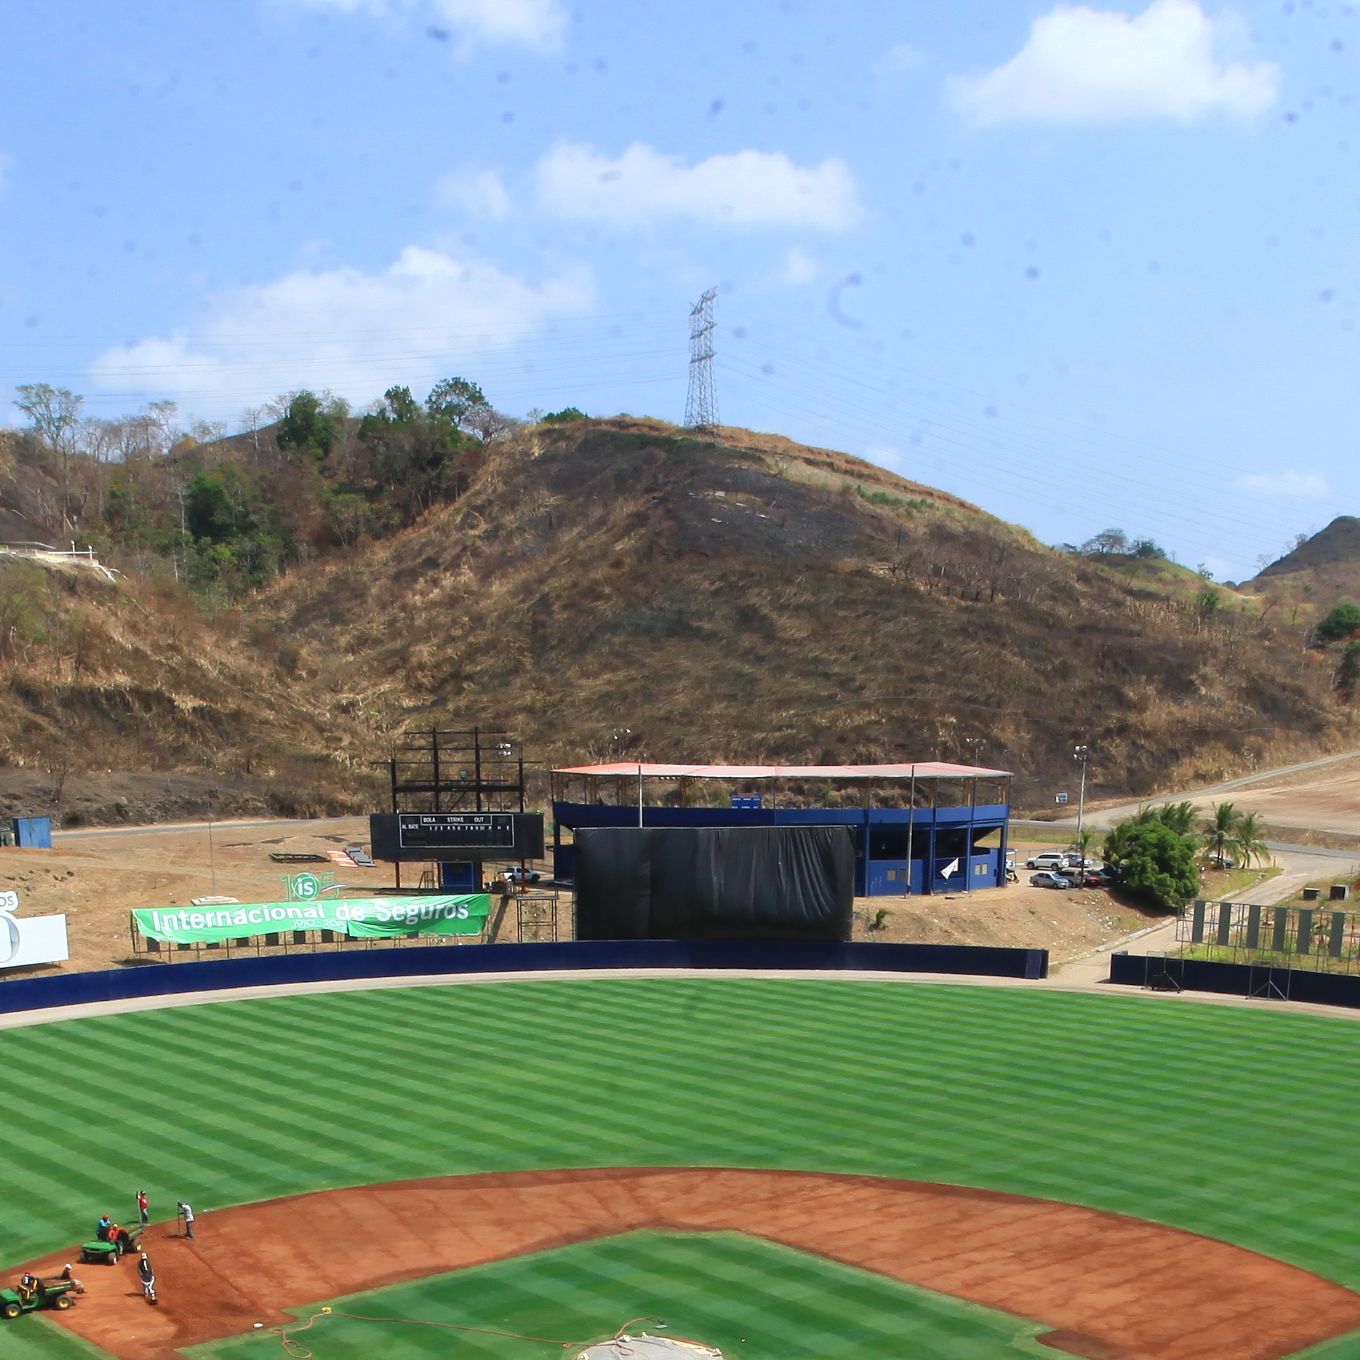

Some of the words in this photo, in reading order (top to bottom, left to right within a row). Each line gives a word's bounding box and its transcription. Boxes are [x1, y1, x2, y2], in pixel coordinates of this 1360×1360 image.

[152, 903, 326, 932] Internacional
[336, 904, 366, 922] de
[374, 900, 469, 925] Seguros
